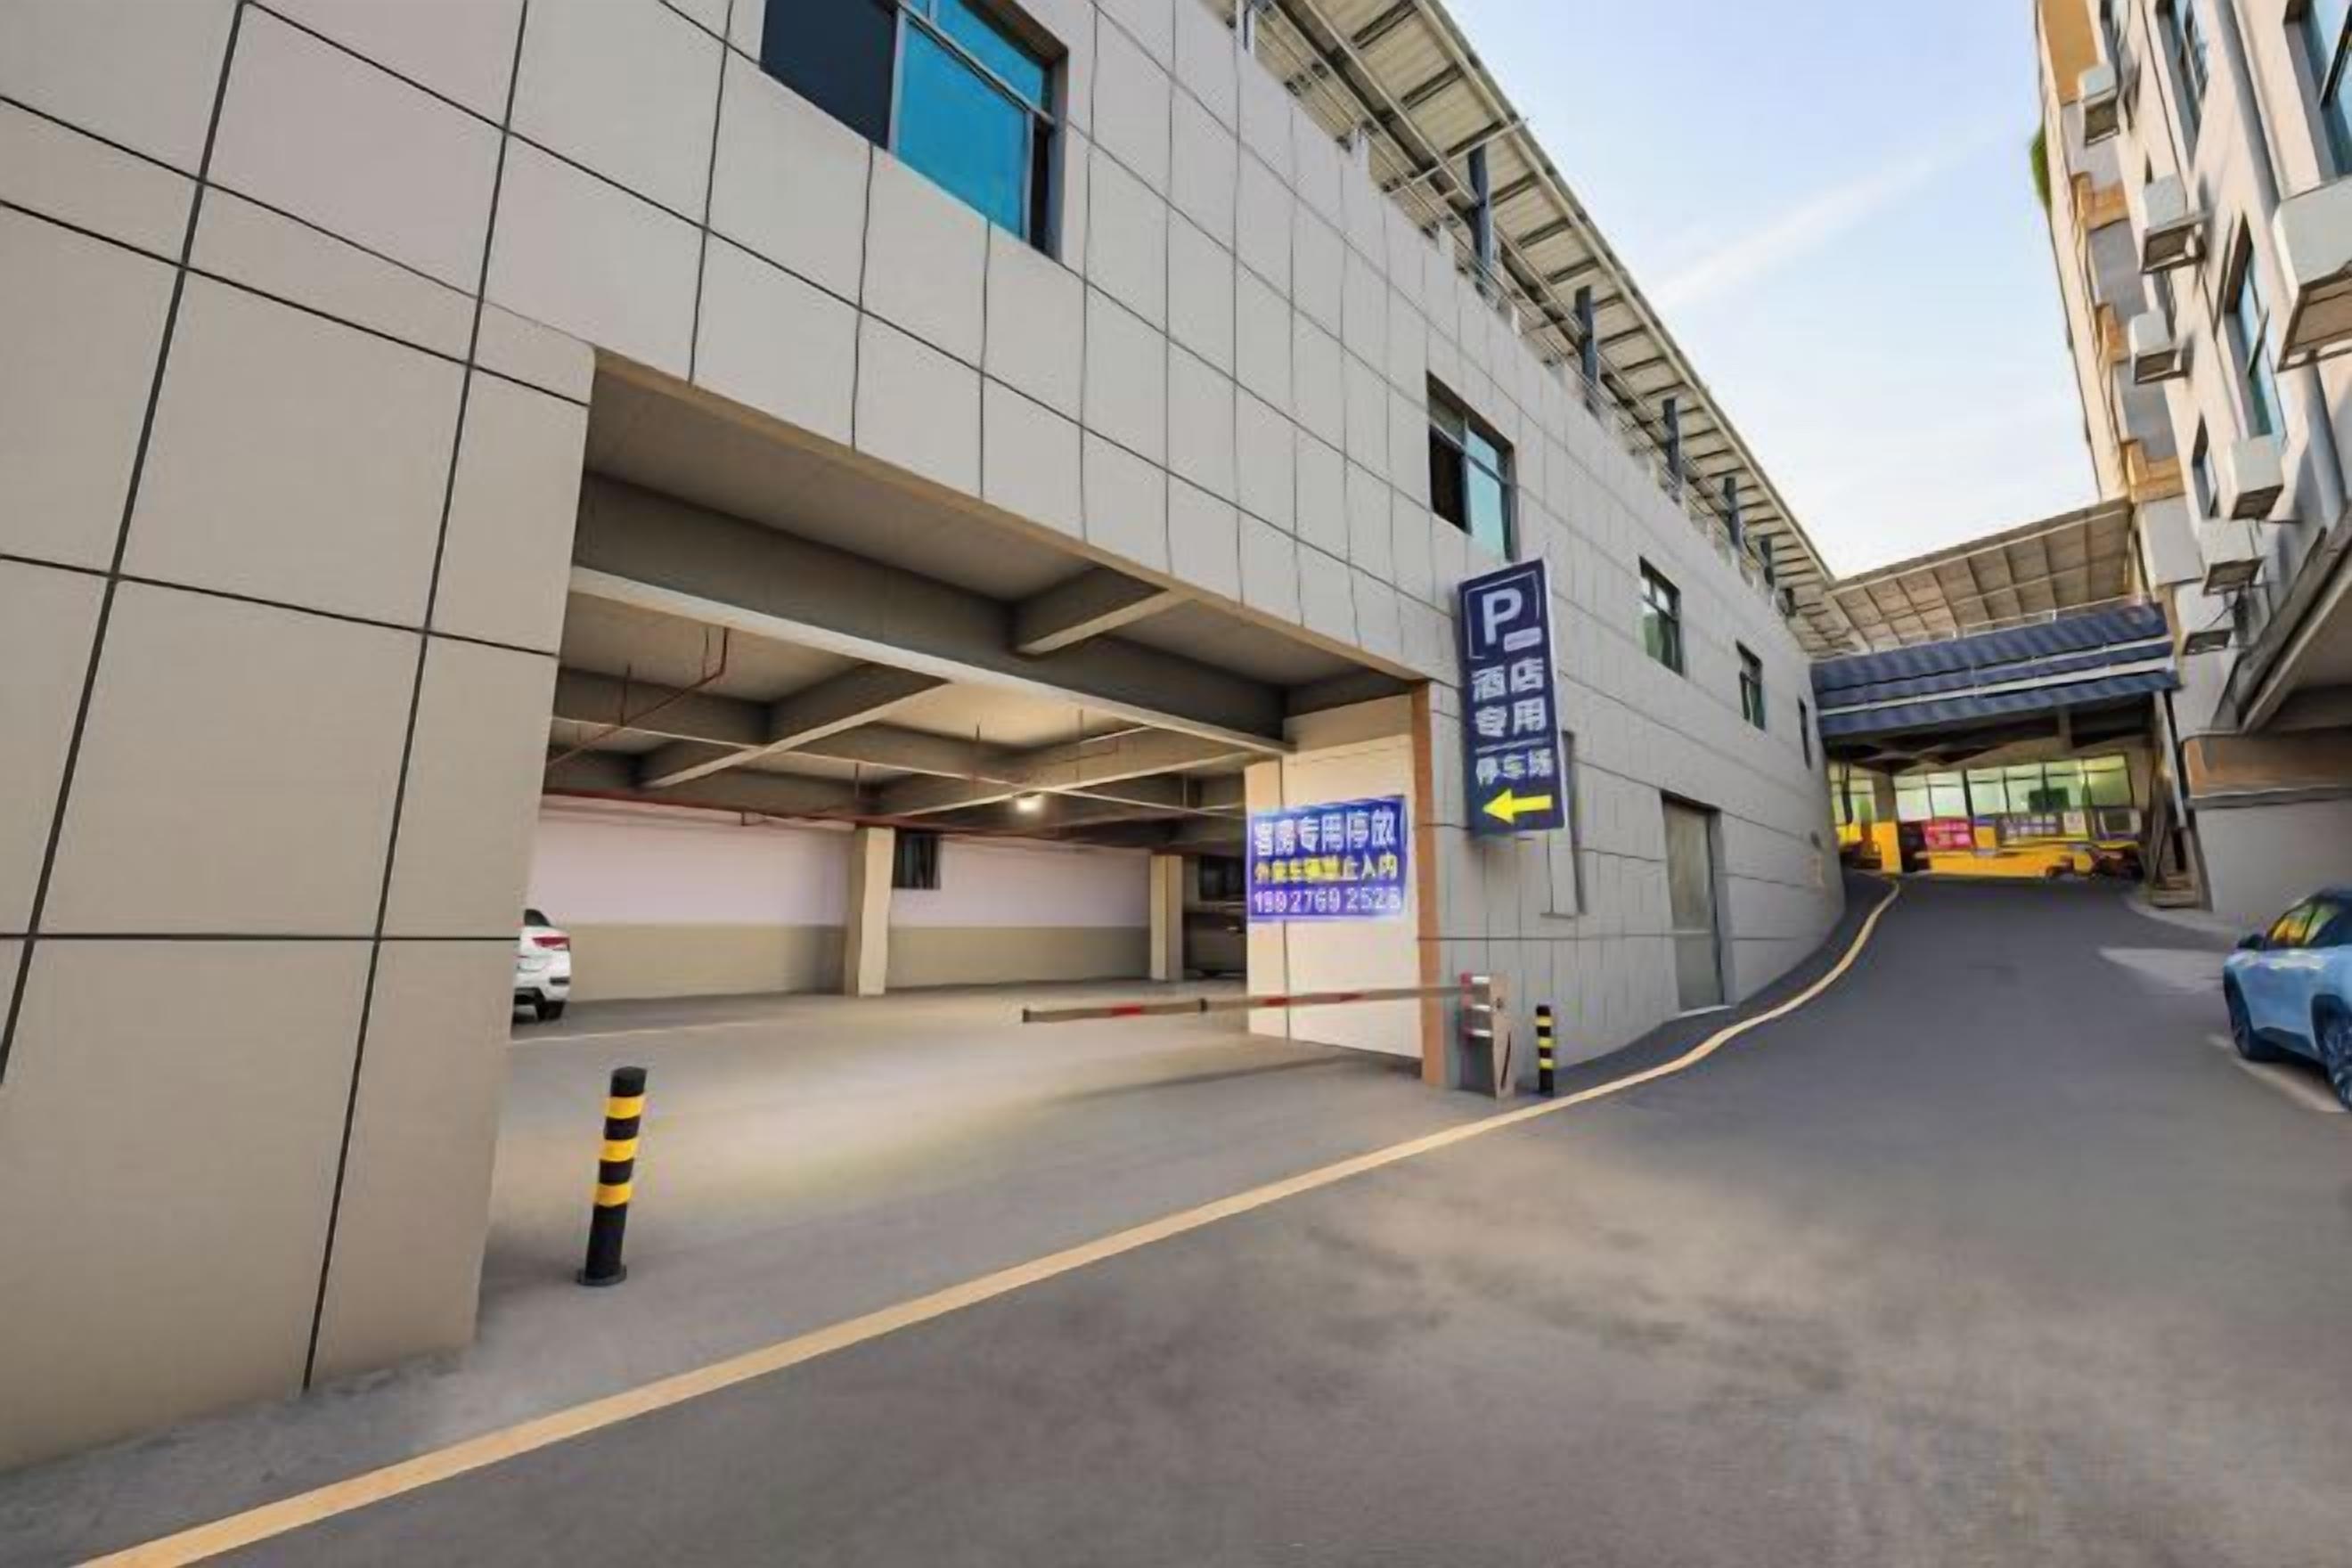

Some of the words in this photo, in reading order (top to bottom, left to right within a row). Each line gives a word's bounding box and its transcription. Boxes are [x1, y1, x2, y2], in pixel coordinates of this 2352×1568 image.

[1482, 587, 1523, 645] P
[1472, 657, 1544, 702] 酒店
[1474, 697, 1547, 737] 专用
[1475, 748, 1554, 786] 停车场
